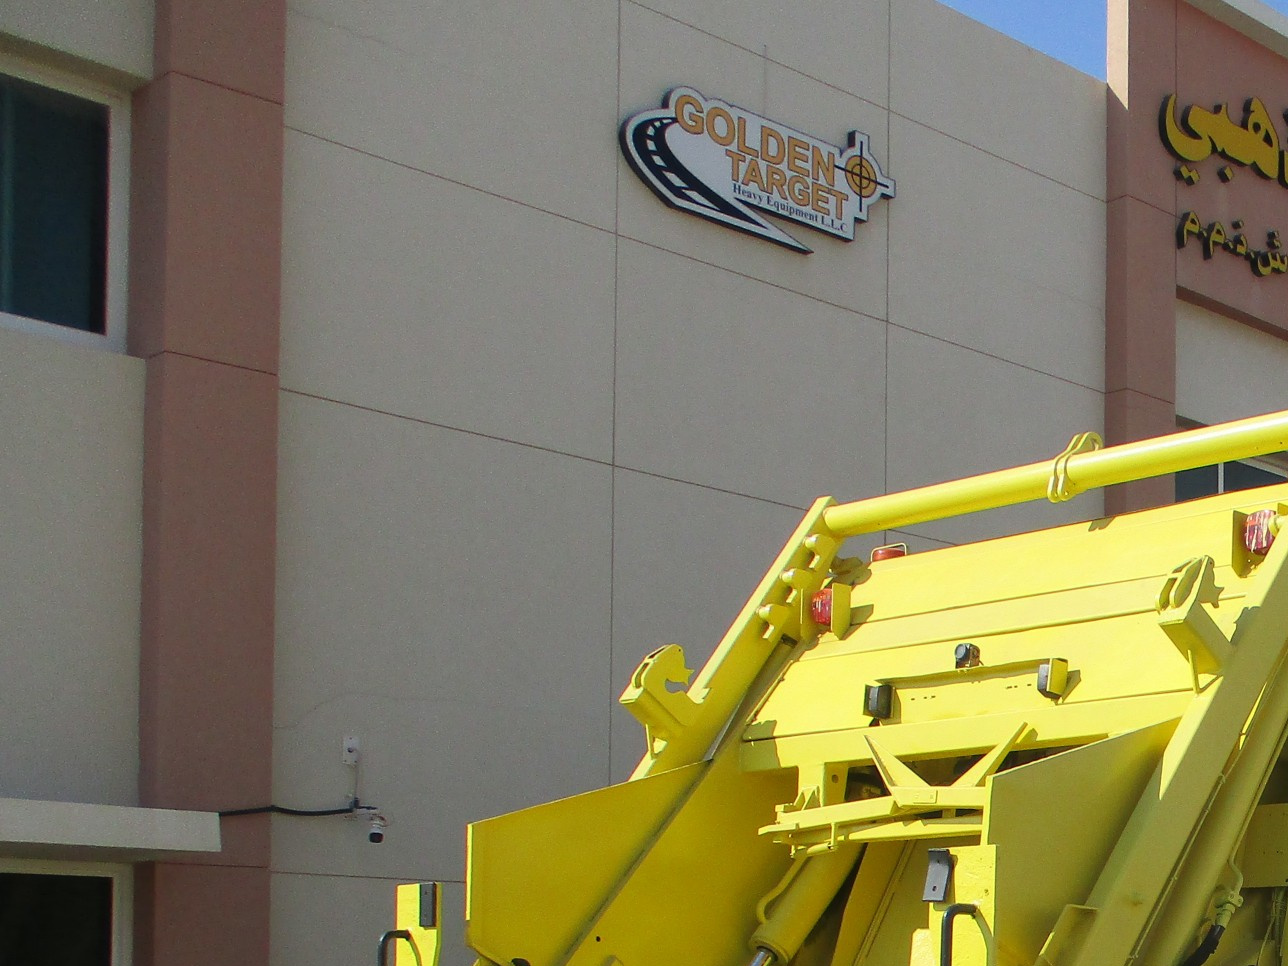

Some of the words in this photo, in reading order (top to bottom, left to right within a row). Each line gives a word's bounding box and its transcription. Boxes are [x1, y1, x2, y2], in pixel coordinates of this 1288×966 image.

[674, 94, 836, 187] GOLDEN
[725, 148, 849, 220] TARGET
[732, 183, 764, 205] Heavy
[766, 195, 818, 223] Equipment
